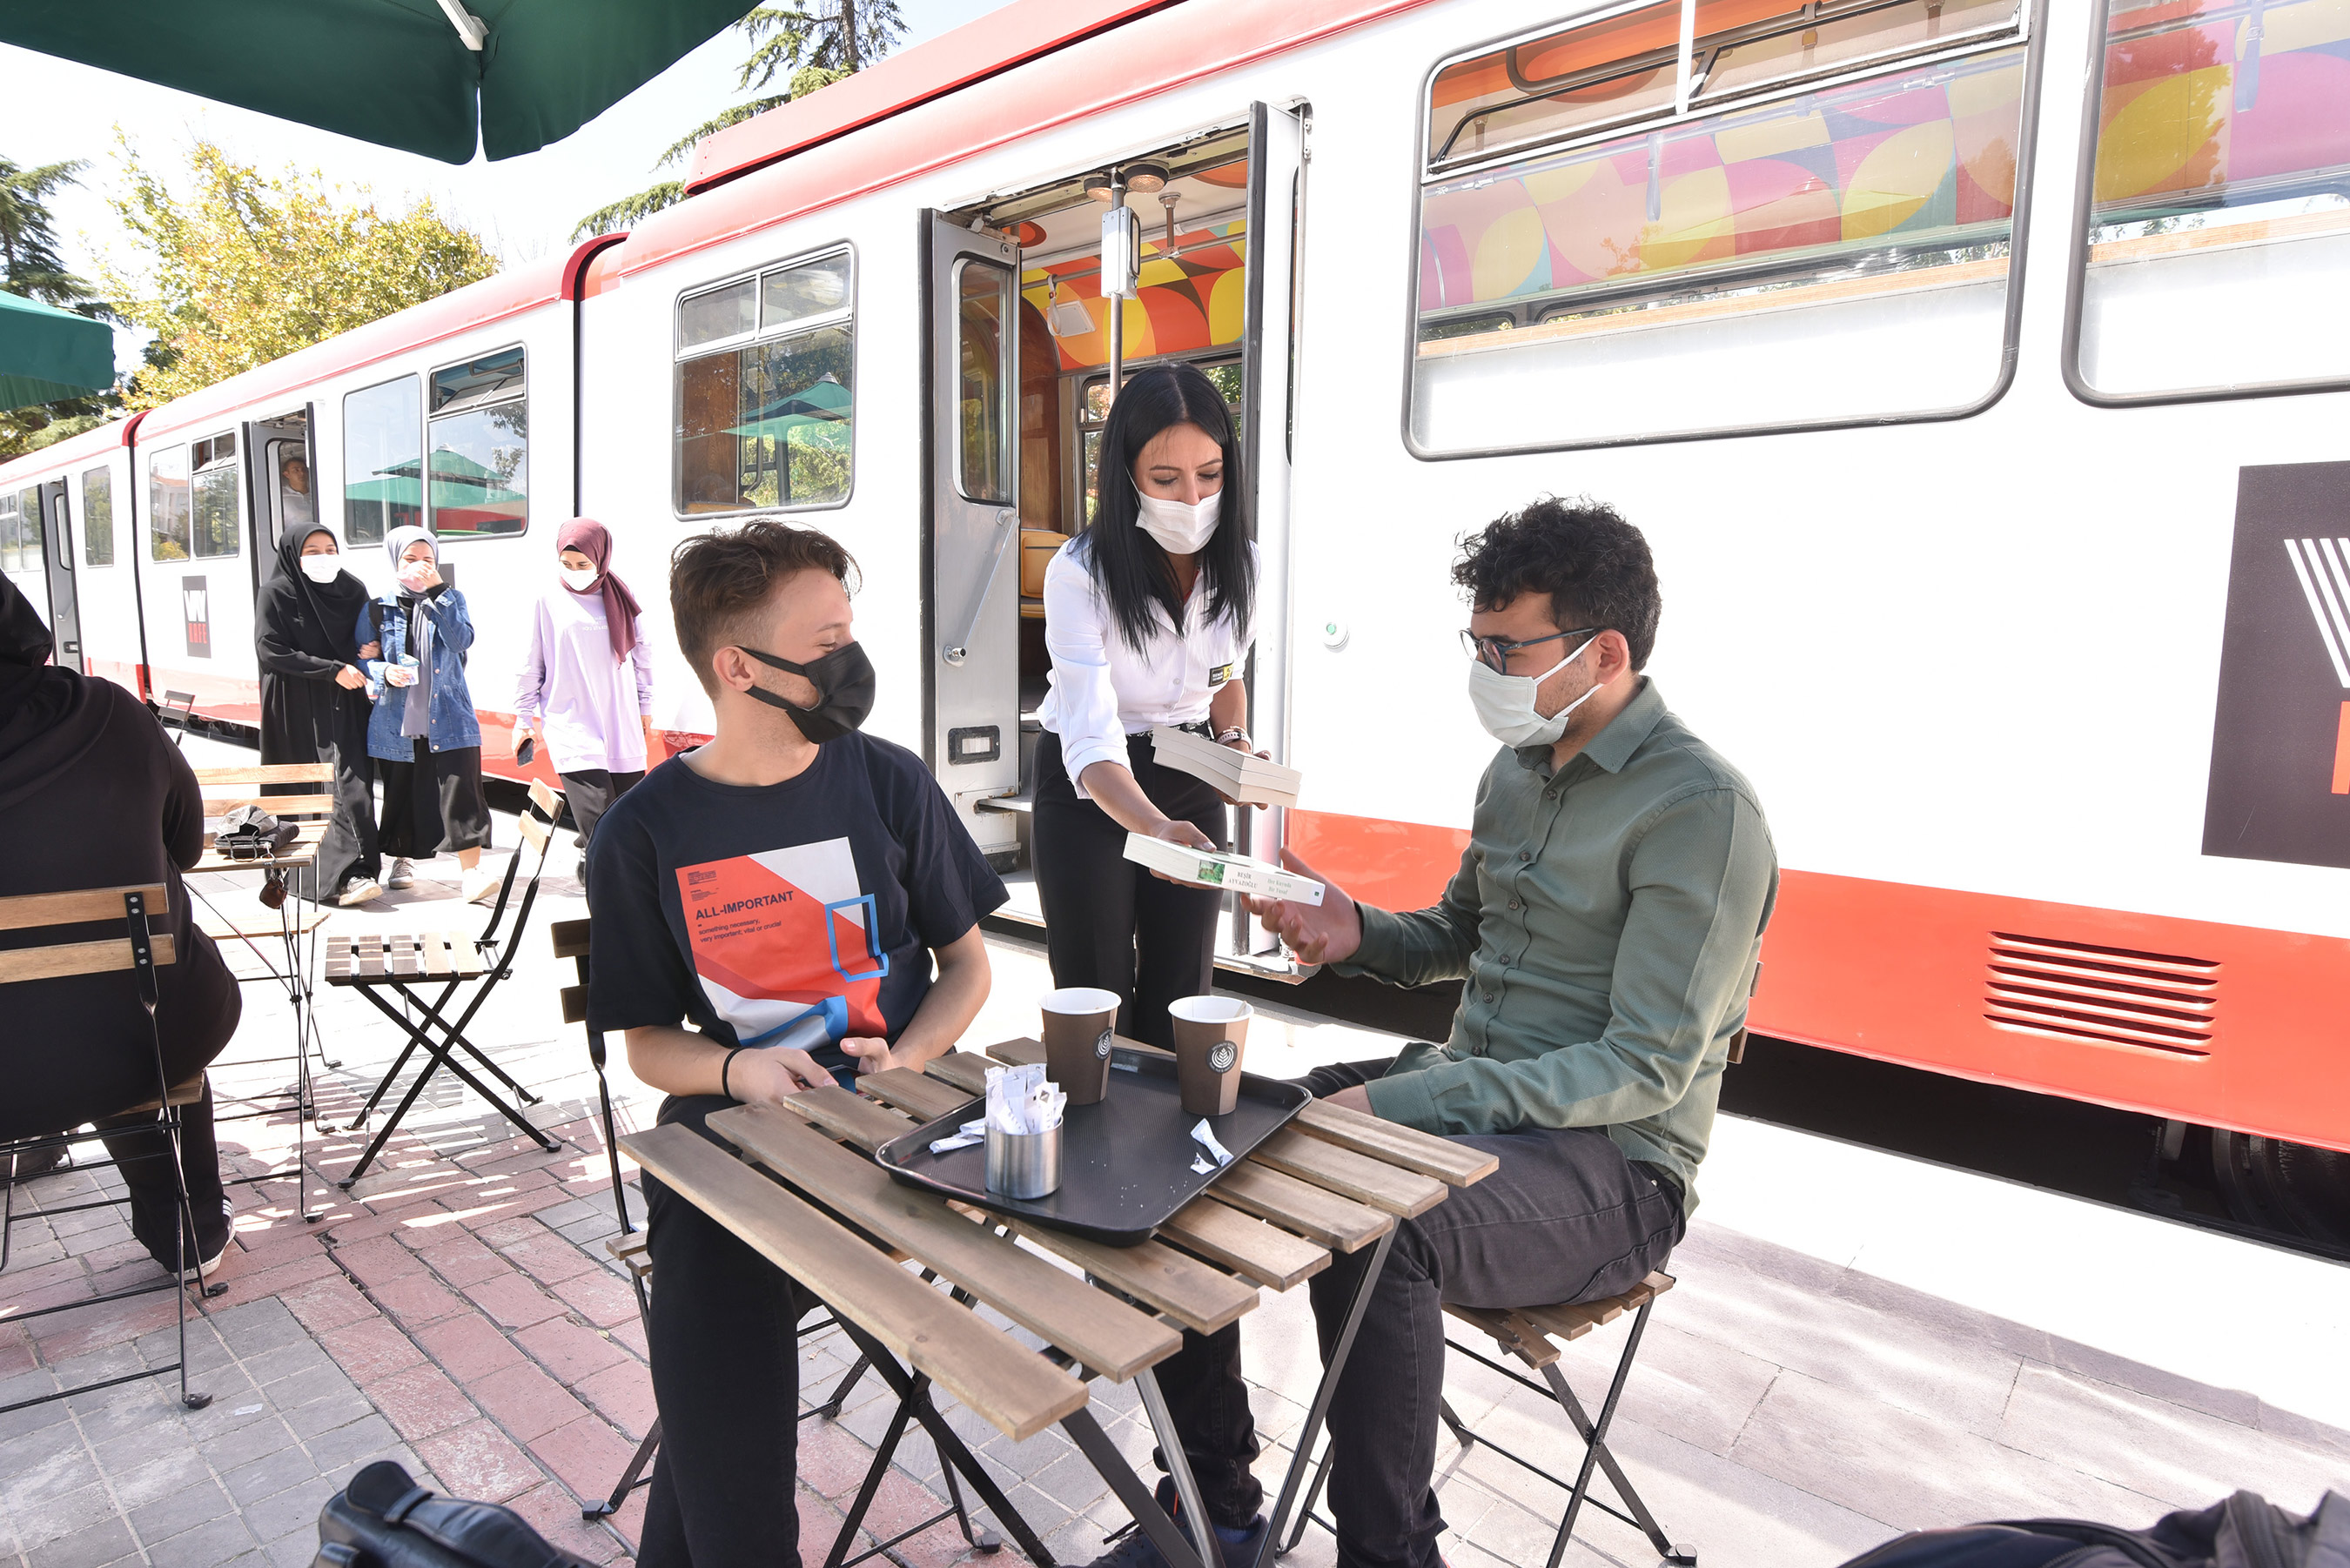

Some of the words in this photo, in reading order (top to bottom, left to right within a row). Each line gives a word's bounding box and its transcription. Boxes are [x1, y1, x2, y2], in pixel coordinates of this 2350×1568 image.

[695, 890, 794, 920] ALL-IMPORTANT
[699, 924, 728, 935] something
[729, 919, 760, 928] necessary,
[743, 926, 755, 935] vital
[763, 921, 782, 930] crucial
